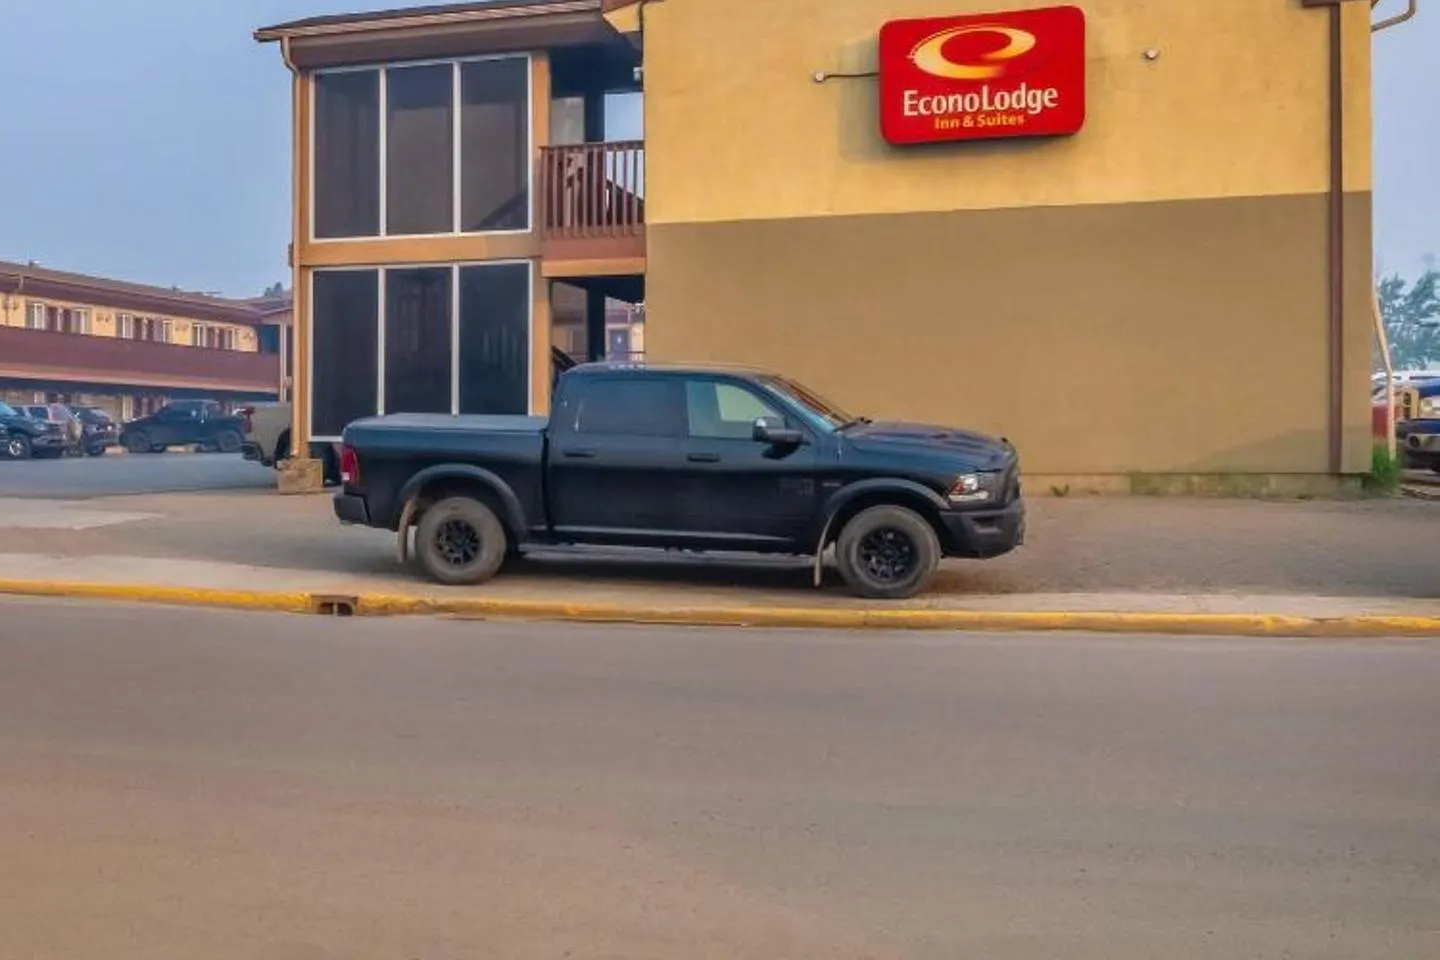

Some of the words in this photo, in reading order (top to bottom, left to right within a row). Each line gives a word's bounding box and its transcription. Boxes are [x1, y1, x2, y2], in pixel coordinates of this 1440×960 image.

[903, 82, 1059, 116] EconoLodge
[934, 117, 959, 129] Inn
[962, 115, 975, 127] &
[976, 113, 1025, 127] Suites
